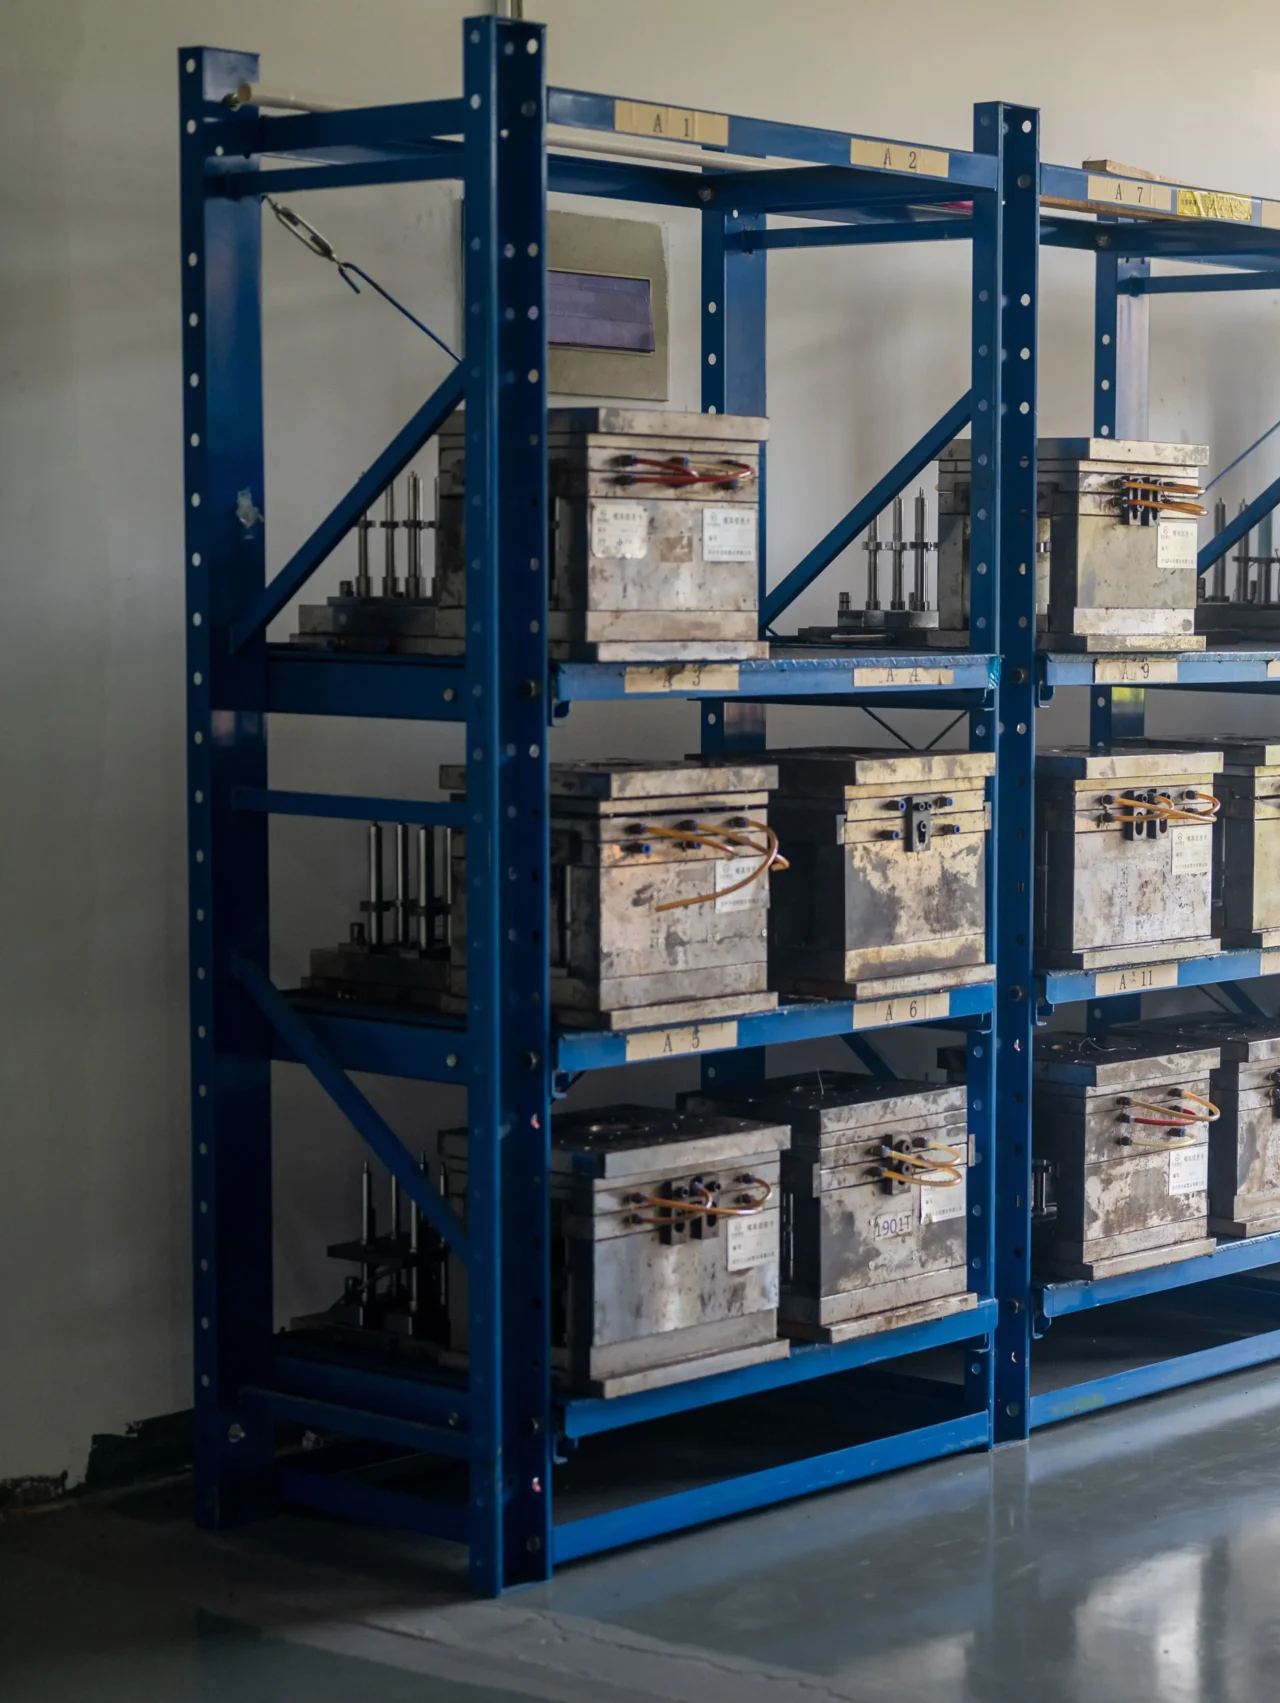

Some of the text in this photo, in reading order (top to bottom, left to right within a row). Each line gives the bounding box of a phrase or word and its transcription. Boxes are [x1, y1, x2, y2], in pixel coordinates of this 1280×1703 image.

[653, 113, 690, 138] A 1
[883, 147, 917, 169] A 2
[1115, 183, 1144, 204] A 7
[662, 671, 701, 688] A 3
[886, 668, 920, 683] A 4
[1122, 662, 1150, 680] A 9
[1119, 970, 1153, 990] A 11
[885, 1000, 917, 1022] A 6
[663, 1030, 700, 1053] A 5
[876, 1214, 911, 1238] 1901T
